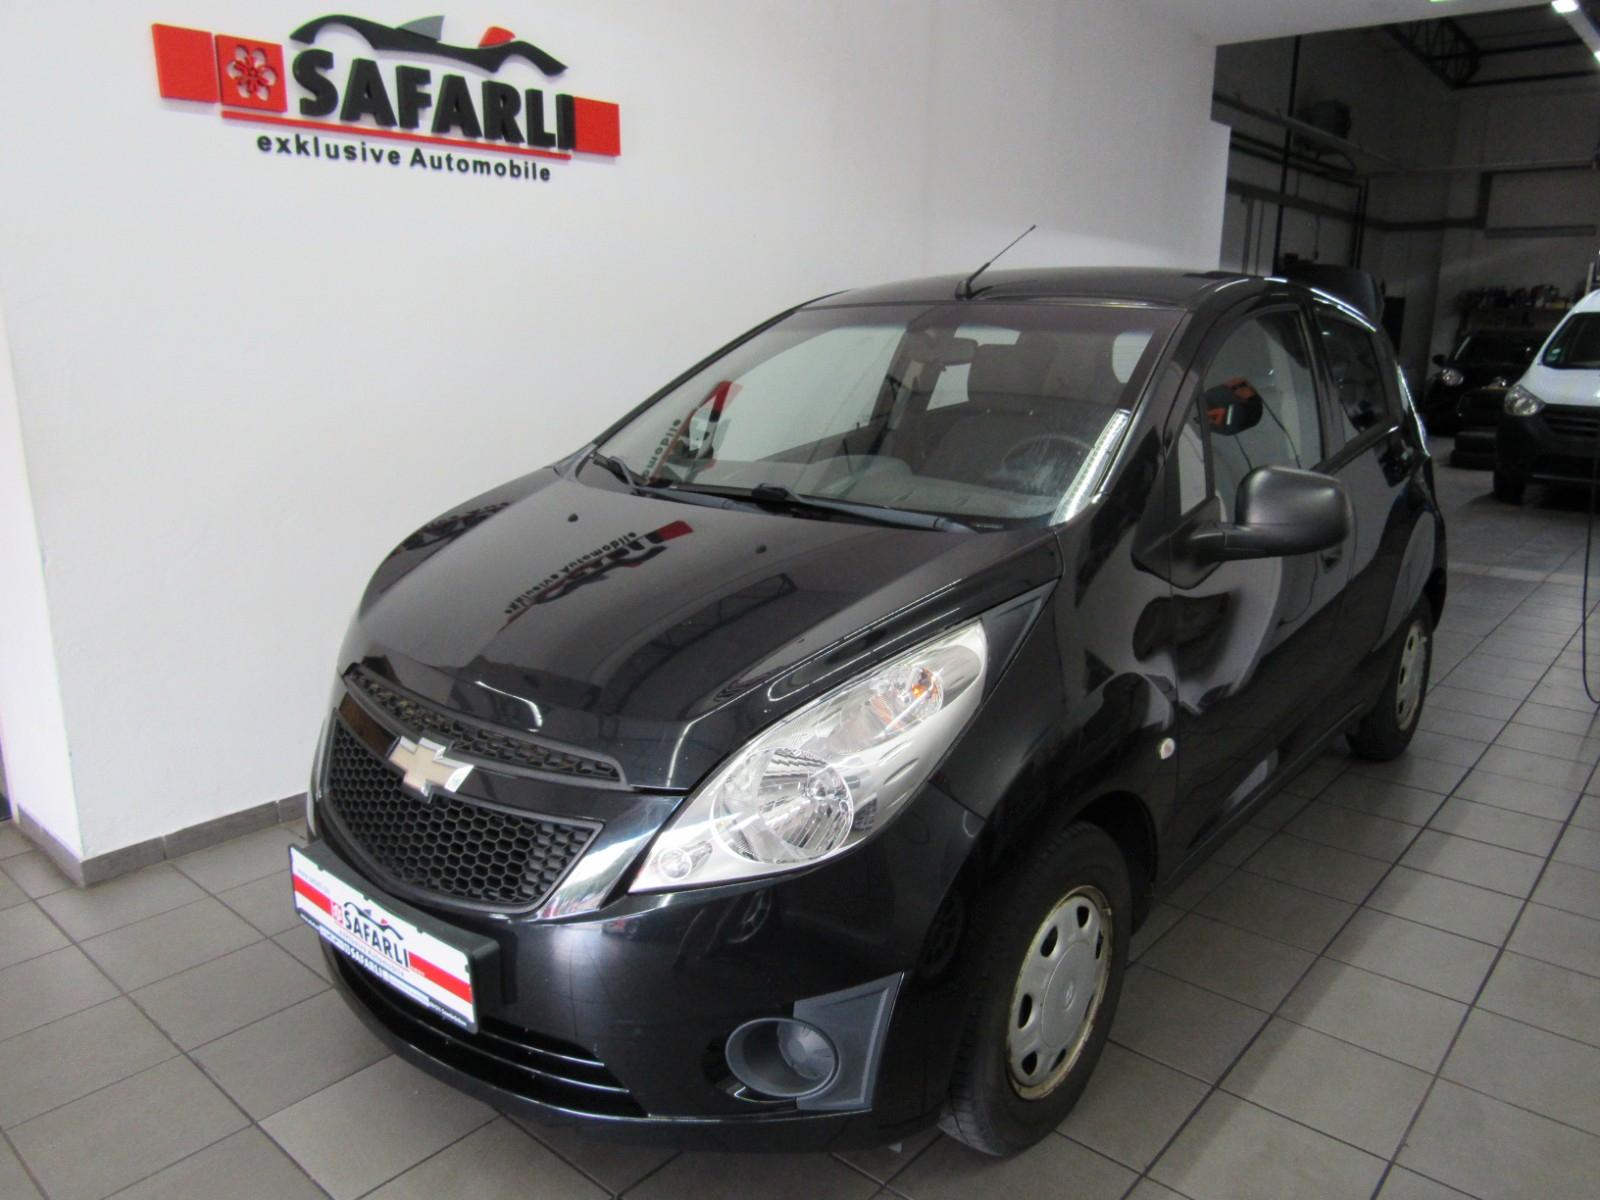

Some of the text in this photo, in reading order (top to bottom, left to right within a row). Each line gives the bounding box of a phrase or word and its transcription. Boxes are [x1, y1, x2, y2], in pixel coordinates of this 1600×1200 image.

[292, 49, 576, 151] SAFARLI
[257, 134, 551, 182] exklusive Automobile
[344, 909, 409, 968] SAFARLI
